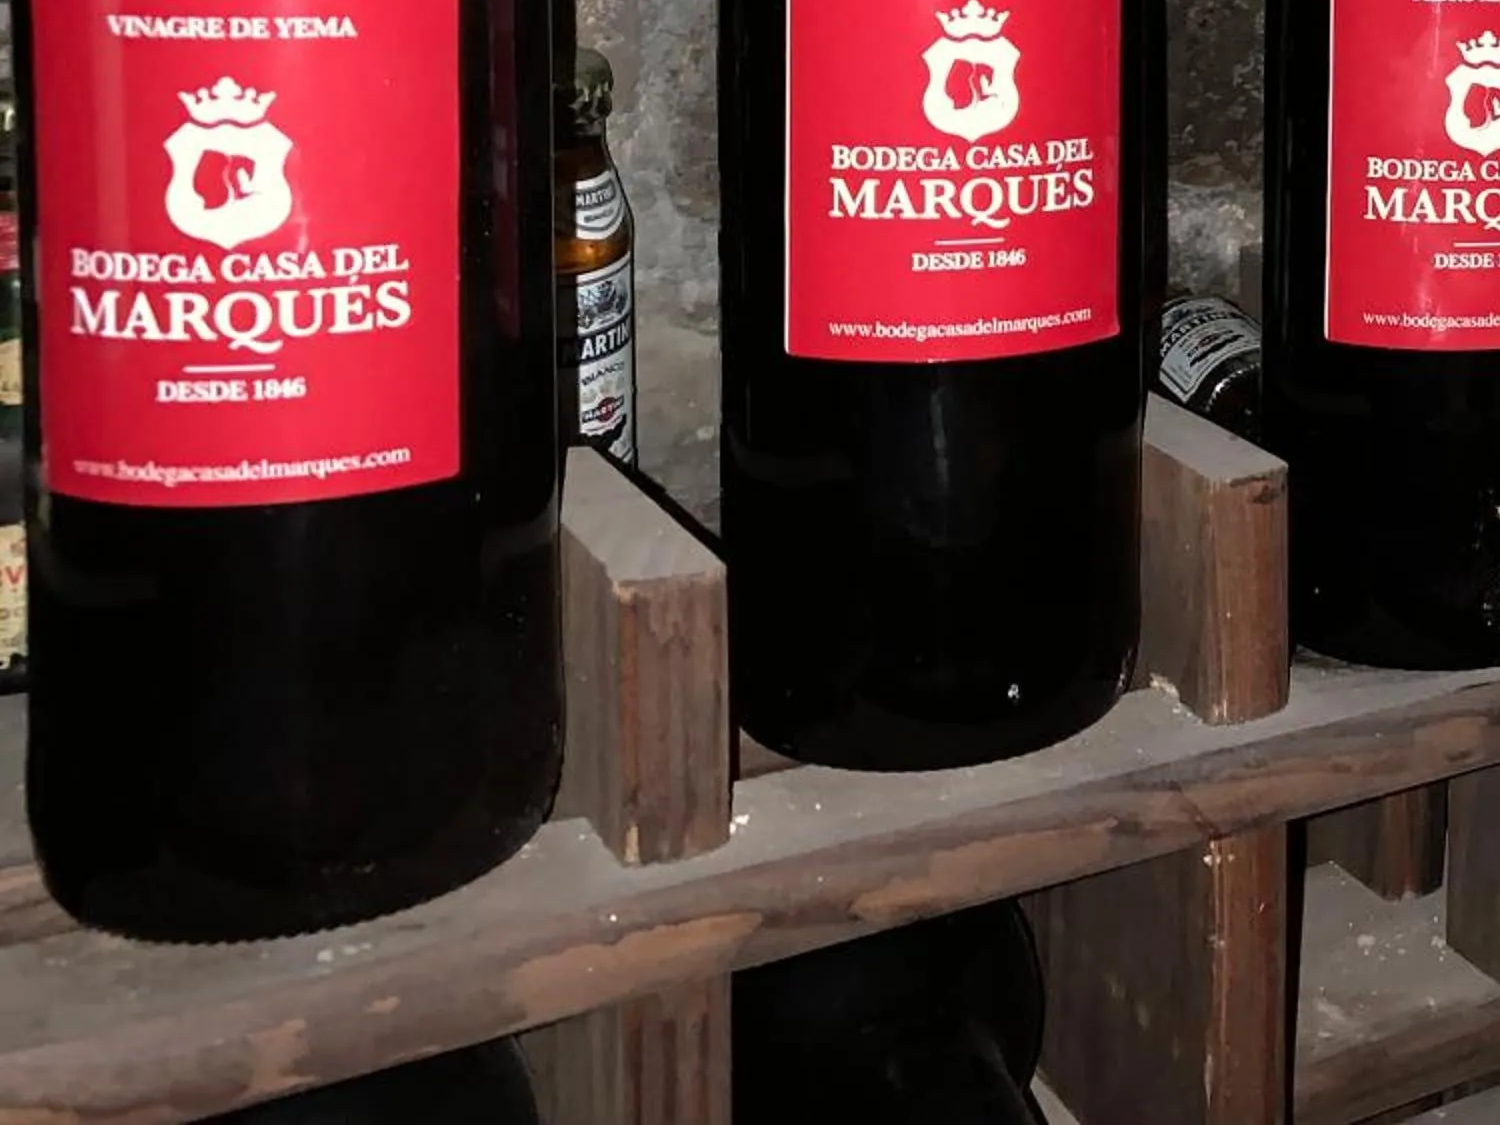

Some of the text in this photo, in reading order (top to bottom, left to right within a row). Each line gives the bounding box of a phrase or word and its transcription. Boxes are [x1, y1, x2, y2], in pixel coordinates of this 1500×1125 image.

[107, 15, 357, 39] VINAGRE DE YEMA
[832, 139, 1093, 171] BODEGA CASA DEL
[1367, 157, 1476, 183] BODEGA
[829, 164, 1094, 229] MARQUÉS
[70, 244, 409, 284] BODEGA CASA DEL
[912, 249, 1026, 271] DESDE 1846
[1434, 253, 1494, 269] DESDE
[70, 277, 412, 352] MARQUÉS
[829, 309, 1091, 342] www.bodegacasadelmarques.com
[158, 377, 306, 402] DESDE 1846
